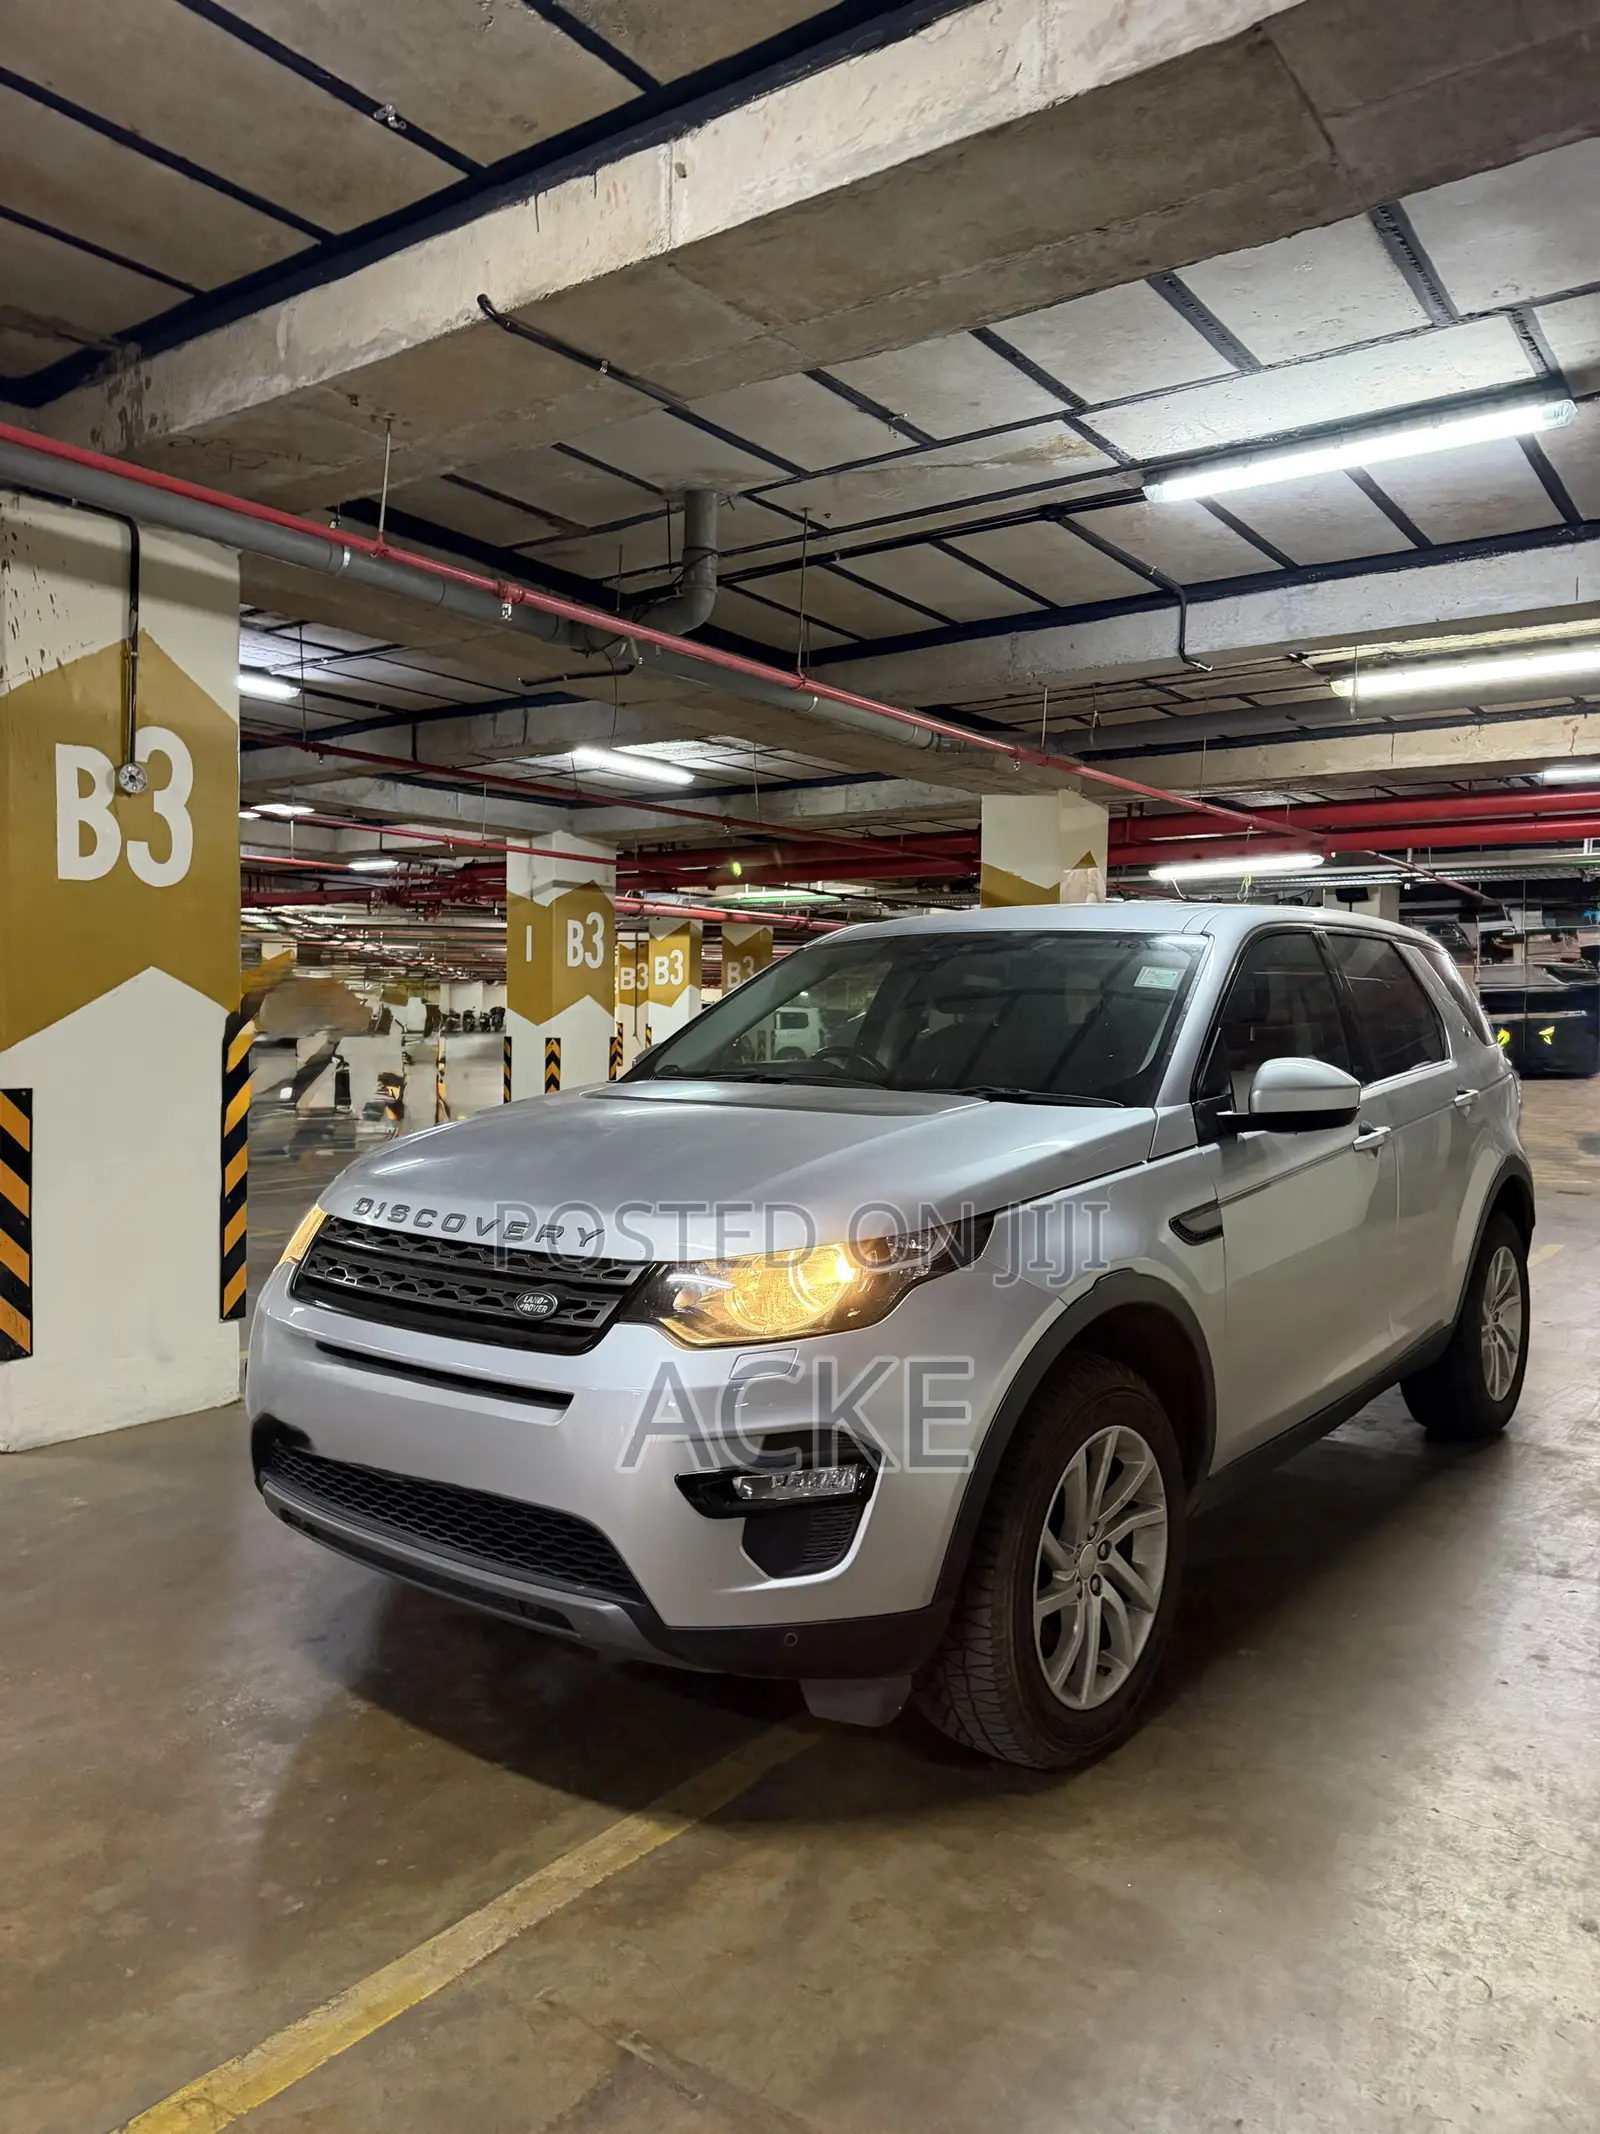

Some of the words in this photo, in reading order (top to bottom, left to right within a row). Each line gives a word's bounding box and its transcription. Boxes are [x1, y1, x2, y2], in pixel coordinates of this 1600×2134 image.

[55, 725, 194, 888] B3
[566, 911, 605, 969] B3
[620, 962, 649, 990] B3
[654, 949, 684, 985] B3
[728, 955, 755, 988] B3
[352, 1197, 605, 1248] DISCOVERY
[522, 1303, 548, 1314] ROVER
[523, 1295, 545, 1304] LAND
